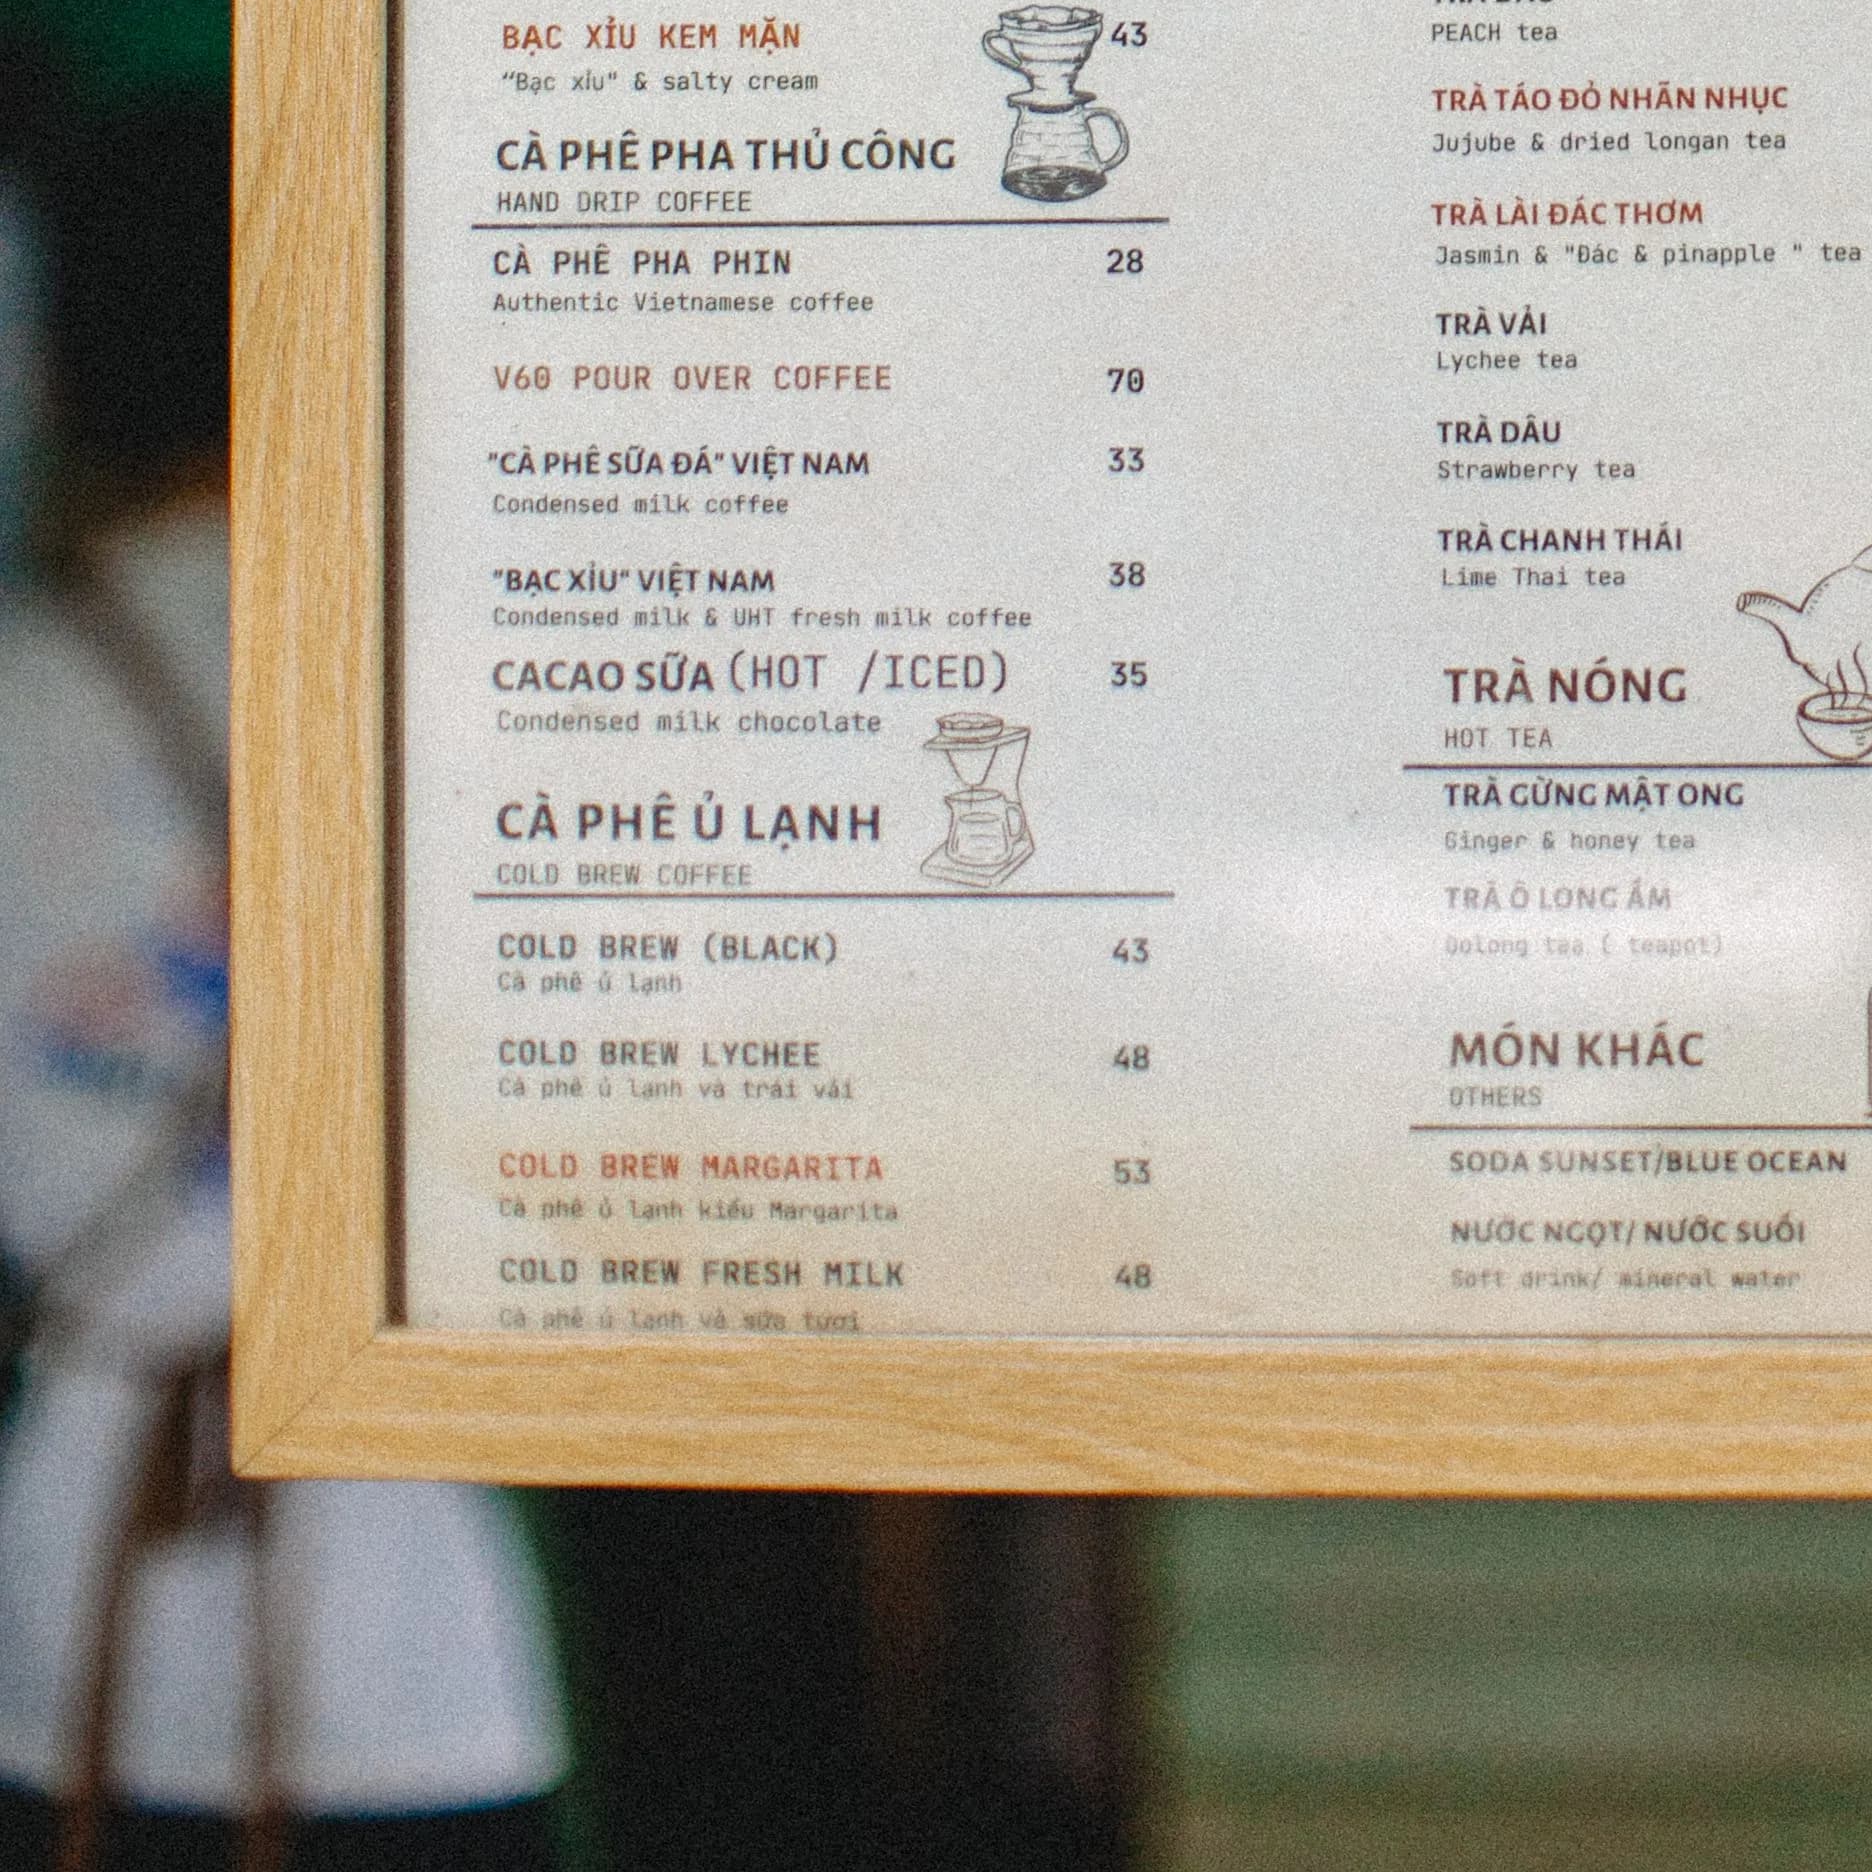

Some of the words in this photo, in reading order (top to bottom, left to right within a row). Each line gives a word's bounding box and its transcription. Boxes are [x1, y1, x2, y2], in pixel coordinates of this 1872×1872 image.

[1430, 21, 1502, 43] PEACH
[1517, 23, 1559, 43] tea
[1432, 131, 1517, 158] Jujube
[1530, 131, 1545, 154] &
[1559, 131, 1631, 153] dried
[1644, 130, 1730, 155] longan
[1744, 130, 1787, 151] tea
[496, 190, 561, 214] HAND
[577, 189, 641, 214] DRIP
[656, 189, 752, 214] COFFEE
[492, 291, 619, 314] Authentic
[633, 291, 775, 314] Vietnamese
[788, 290, 875, 313] coffee
[1436, 350, 1522, 375] Lychee
[1536, 349, 1579, 371] tea
[493, 364, 552, 392] V60
[573, 364, 652, 392] POUR
[672, 364, 752, 392] OVER
[773, 364, 891, 392] COFFEE
[1106, 366, 1146, 395] 70
[492, 493, 620, 516] Condensed
[632, 493, 691, 515] milk
[704, 493, 790, 516] coffee
[1441, 566, 1498, 589] Lime
[1513, 566, 1569, 589] Thai
[1584, 567, 1627, 589] tea
[1443, 656, 1534, 705] TRÀ
[1548, 656, 1687, 704] NÓNG
[1443, 726, 1489, 750] HOT
[1506, 726, 1553, 750] TEA
[499, 1038, 578, 1066] COLD
[599, 1039, 680, 1067] BREW
[702, 1039, 821, 1069] LYCHEE
[1450, 1020, 1560, 1068] MÓN
[1576, 1020, 1705, 1068] KHÁC
[1112, 1044, 1151, 1072] 48
[1448, 1084, 1542, 1109] OTHERS
[1449, 1150, 1529, 1173] SODA
[1539, 1148, 1739, 1176] SUNSET/BLUE
[1745, 1148, 1848, 1174] OCEAN
